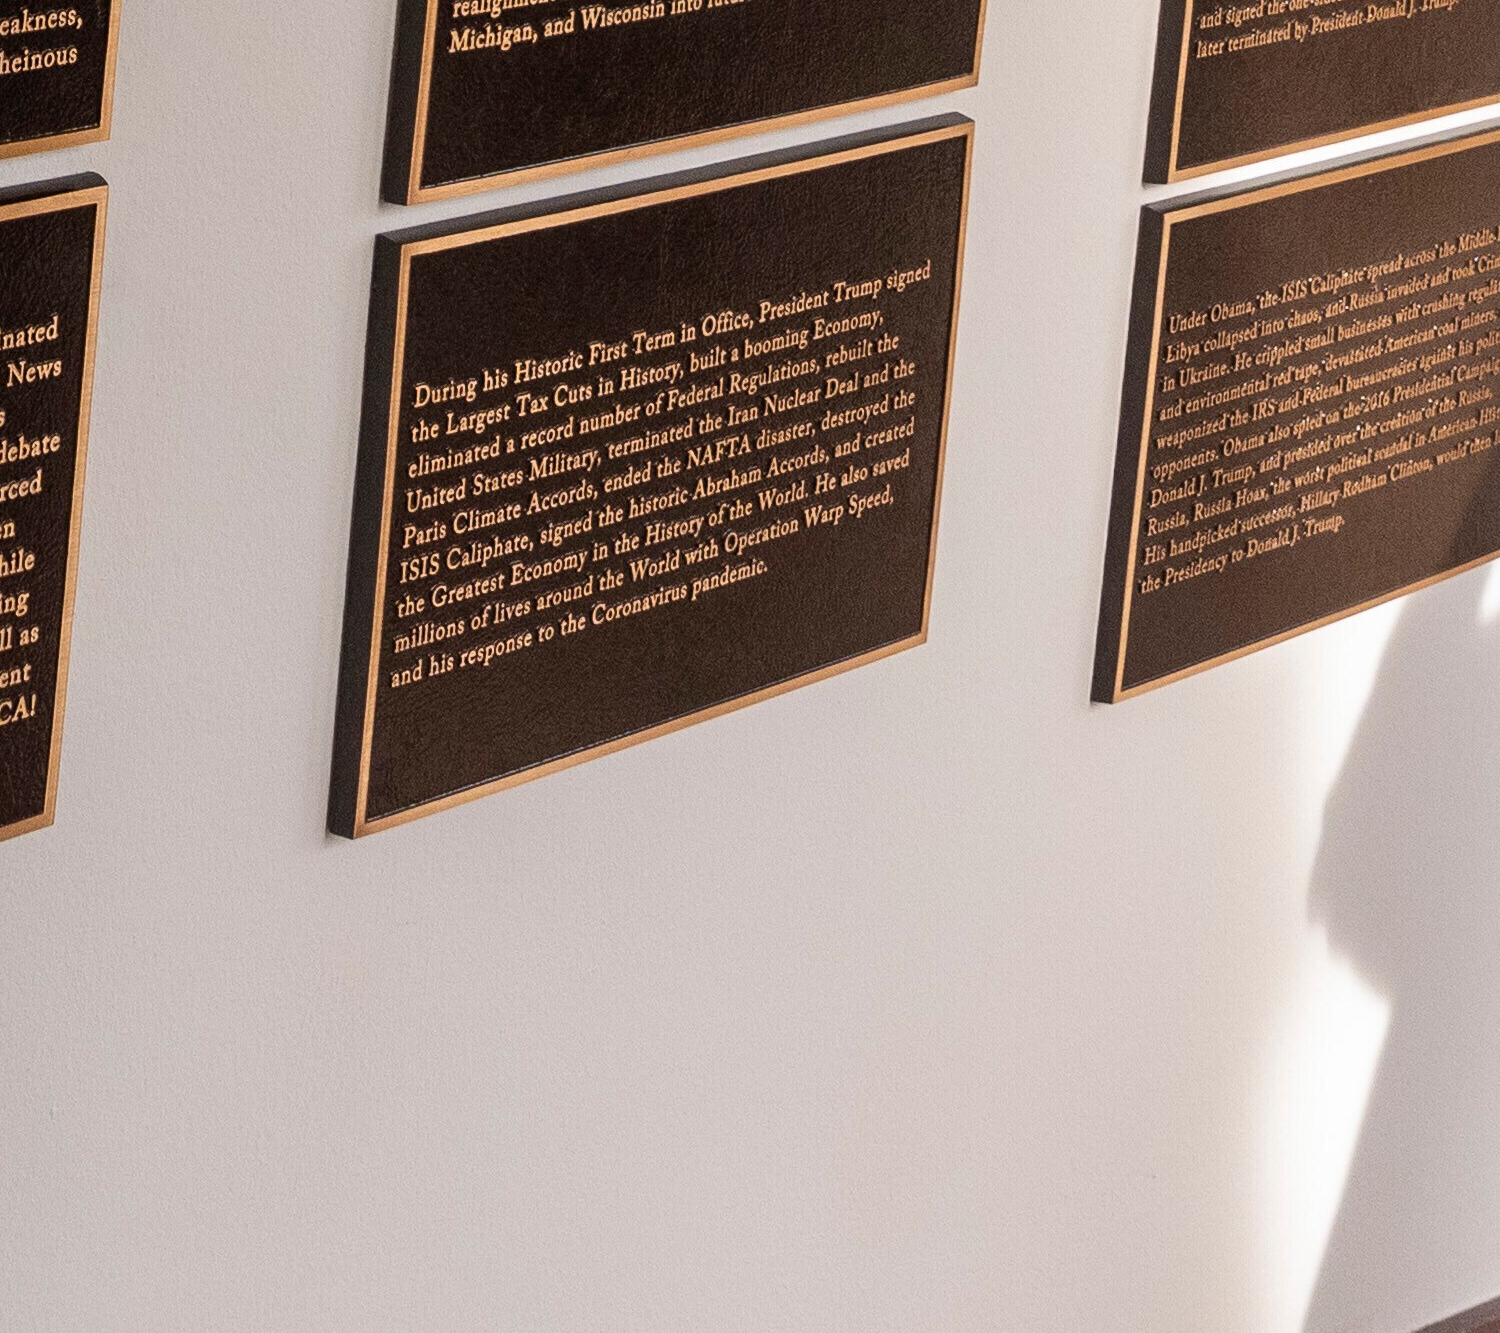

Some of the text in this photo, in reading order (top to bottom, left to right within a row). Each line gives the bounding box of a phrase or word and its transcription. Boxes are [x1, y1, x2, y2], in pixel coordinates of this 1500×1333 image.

[448, 23, 538, 54] Michigan,
[544, 9, 575, 38] and
[1169, 310, 1208, 335] Under
[1259, 290, 1278, 310] the
[1281, 279, 1308, 304] ISIS
[1311, 267, 1365, 295] Caliphate
[1367, 253, 1403, 283] spread
[1404, 249, 1437, 269] across
[1439, 241, 1456, 259] the
[1458, 229, 1494, 254] Middle
[414, 259, 931, 409] During his Historic First Term in Office, President Trump signed
[1141, 574, 1161, 595] the
[1164, 554, 1228, 587] Presidency
[1231, 549, 1244, 563] to
[1246, 527, 1290, 559] Donald
